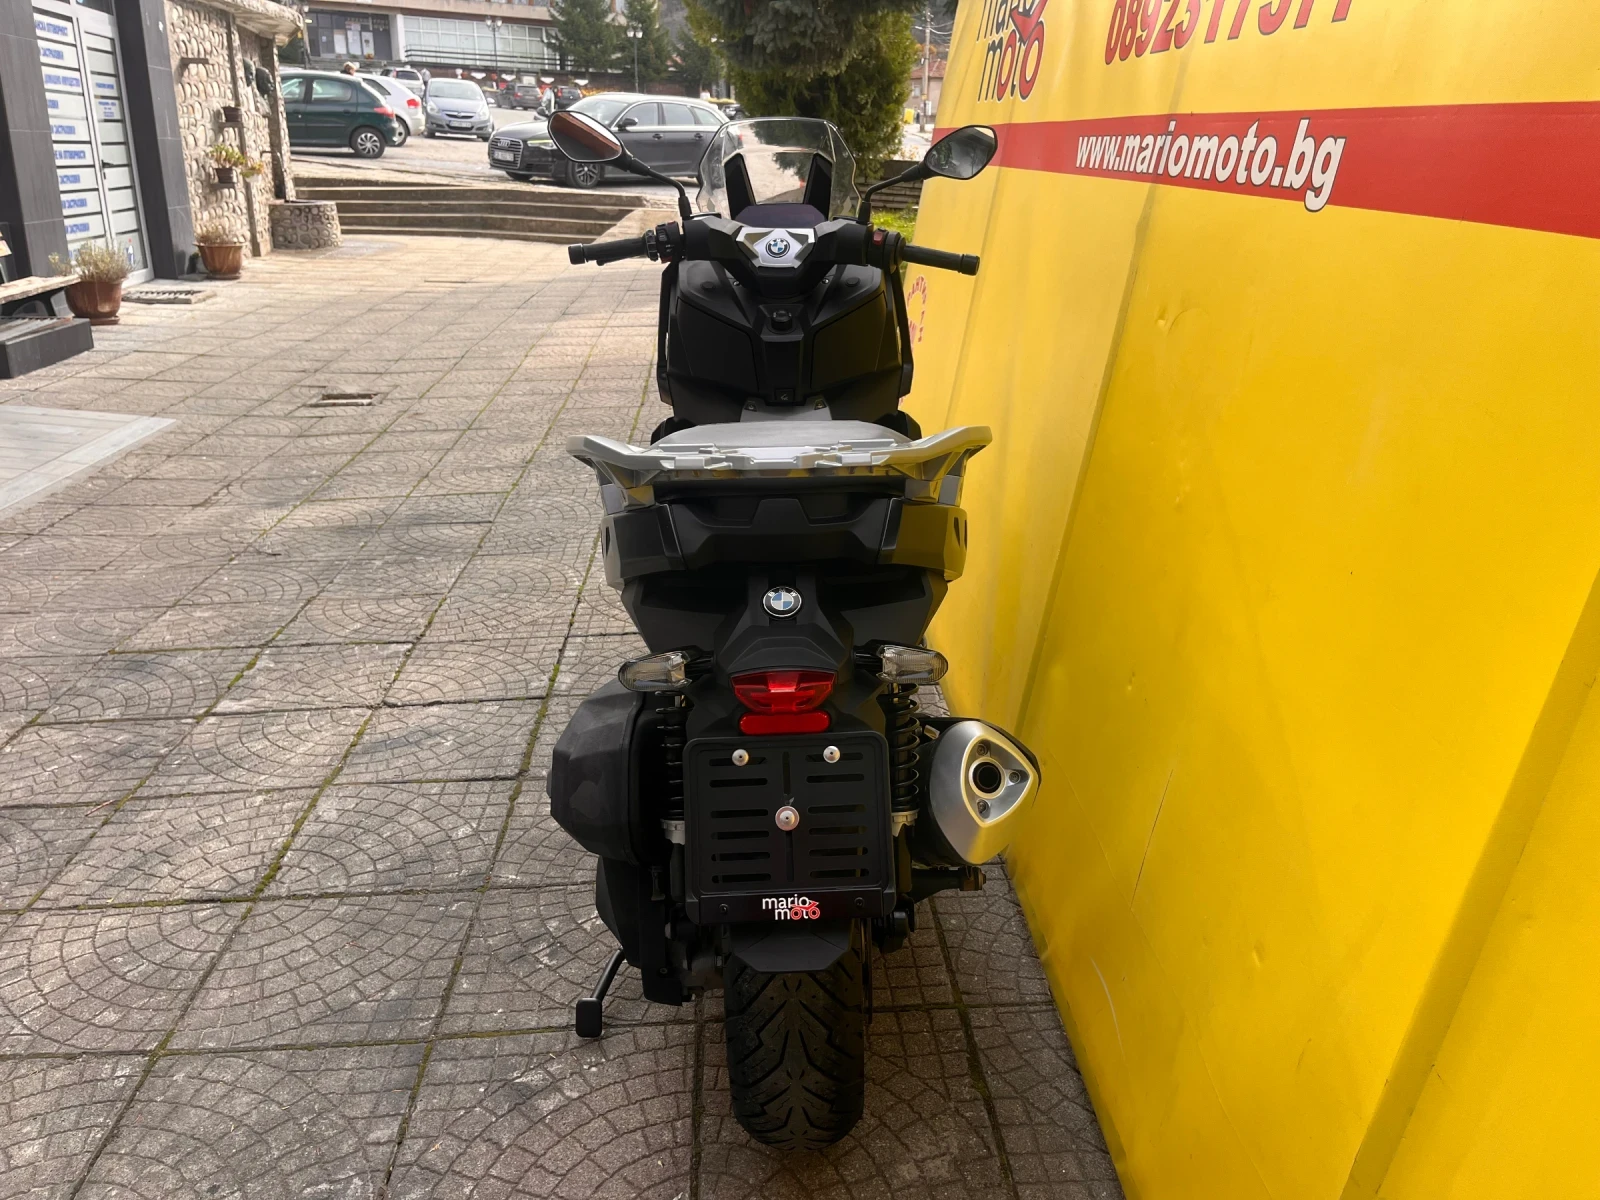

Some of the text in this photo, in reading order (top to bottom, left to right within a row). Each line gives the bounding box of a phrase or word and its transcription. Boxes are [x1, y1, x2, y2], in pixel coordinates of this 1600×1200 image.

[977, 20, 1045, 101] moto
[1075, 117, 1347, 212] www.mariomoto.bg
[762, 893, 810, 909] mario
[775, 907, 820, 920] moto
